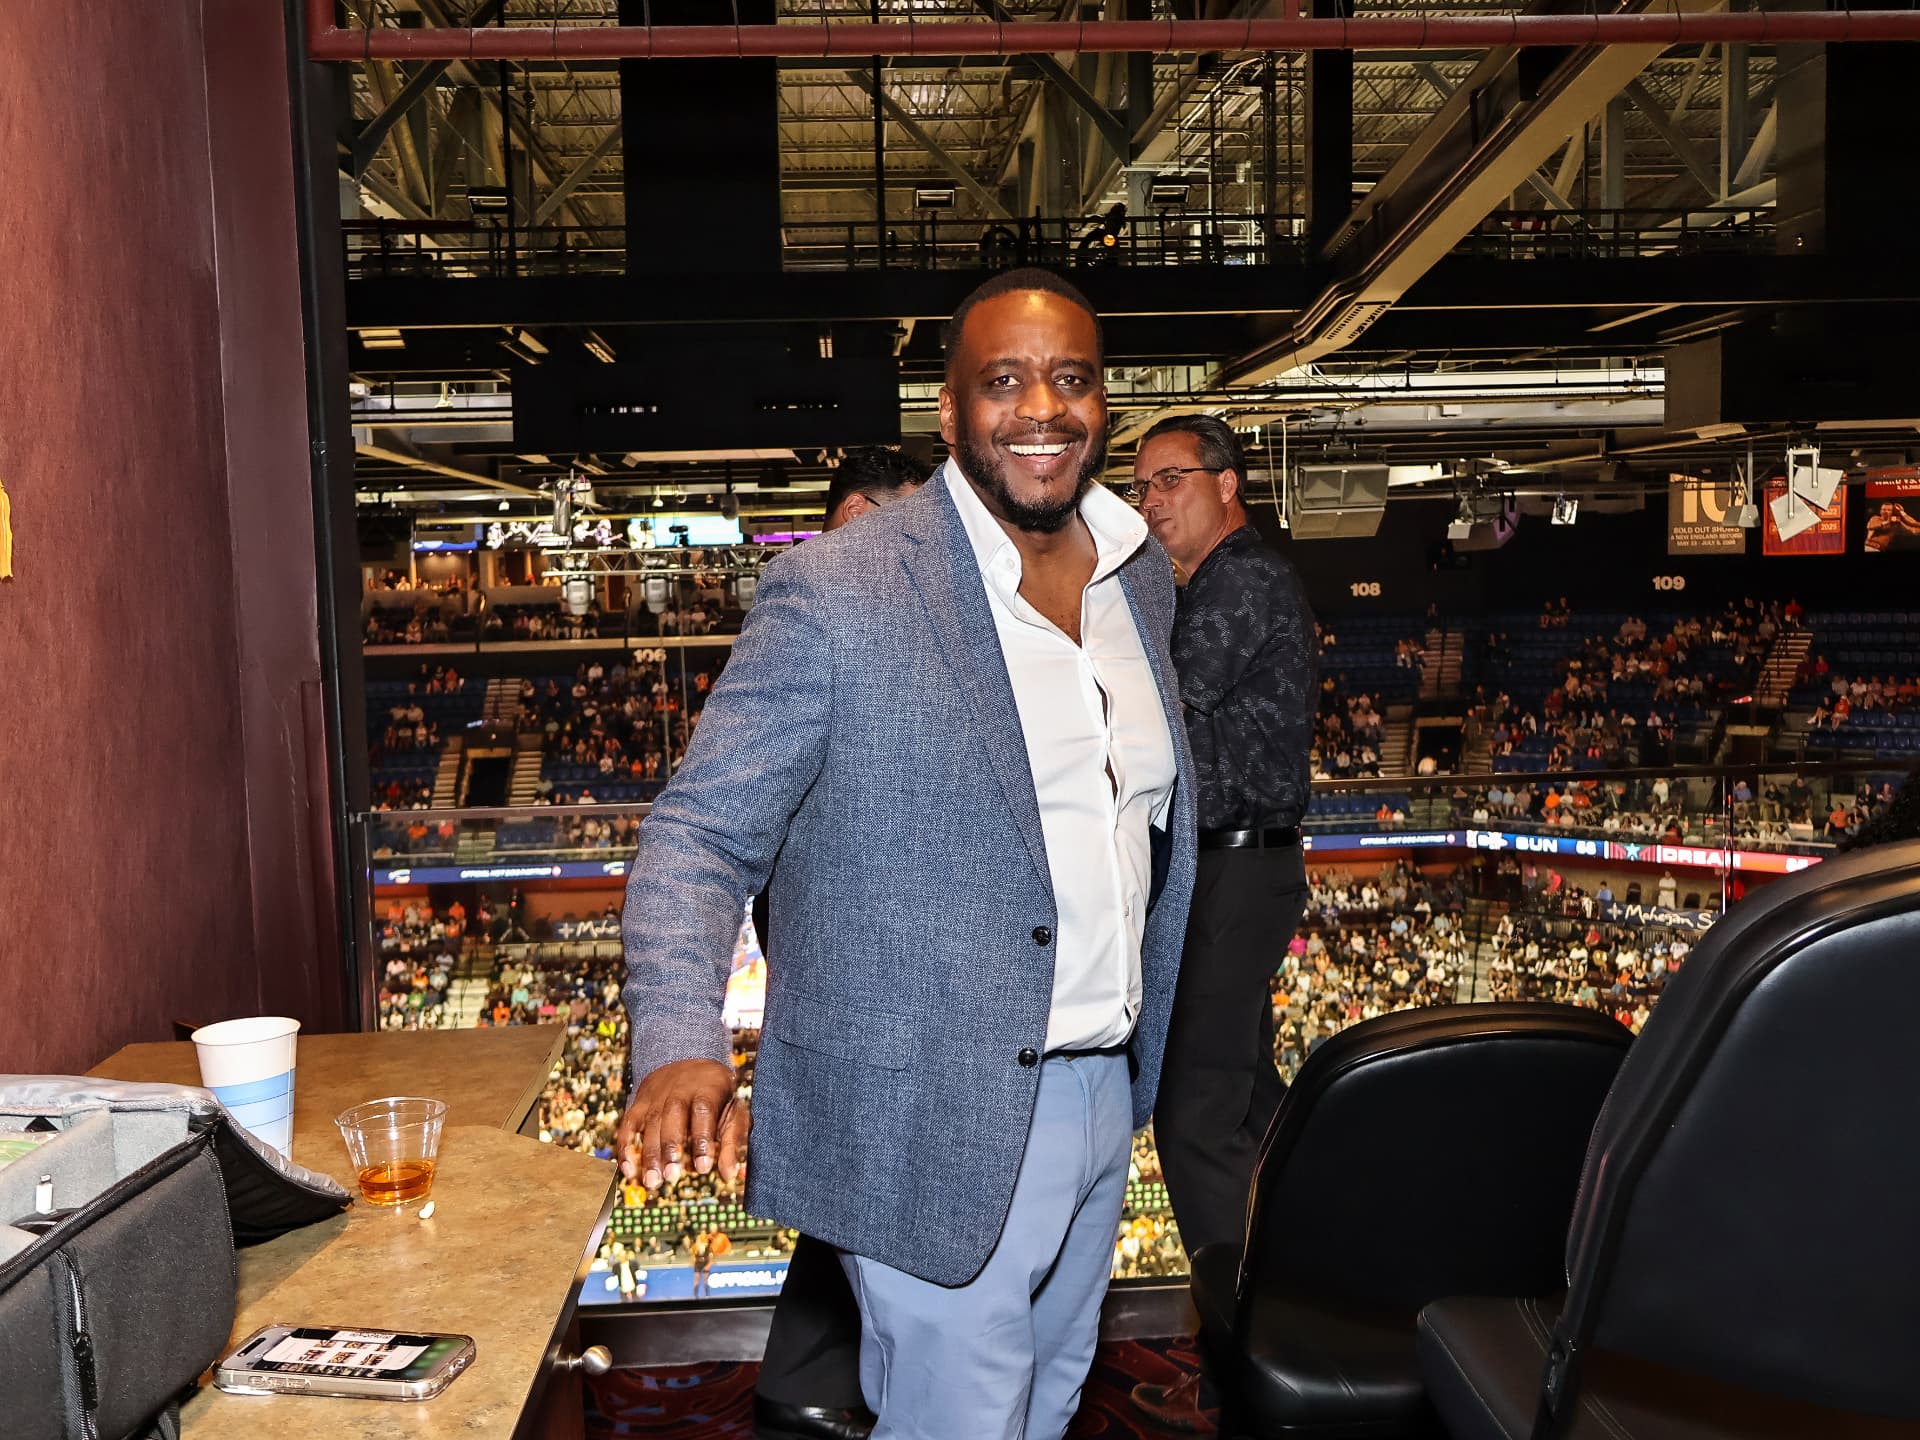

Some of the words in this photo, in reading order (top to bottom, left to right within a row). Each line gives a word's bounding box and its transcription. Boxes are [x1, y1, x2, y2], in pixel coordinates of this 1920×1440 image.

[1673, 526, 1693, 534] SOLD
[1350, 582, 1381, 597] 108
[1652, 575, 1686, 591] 109
[634, 648, 667, 663] 106
[1515, 837, 1558, 853] SUN
[1662, 847, 1741, 867] DREAM
[1625, 904, 1694, 928] Mohegan
